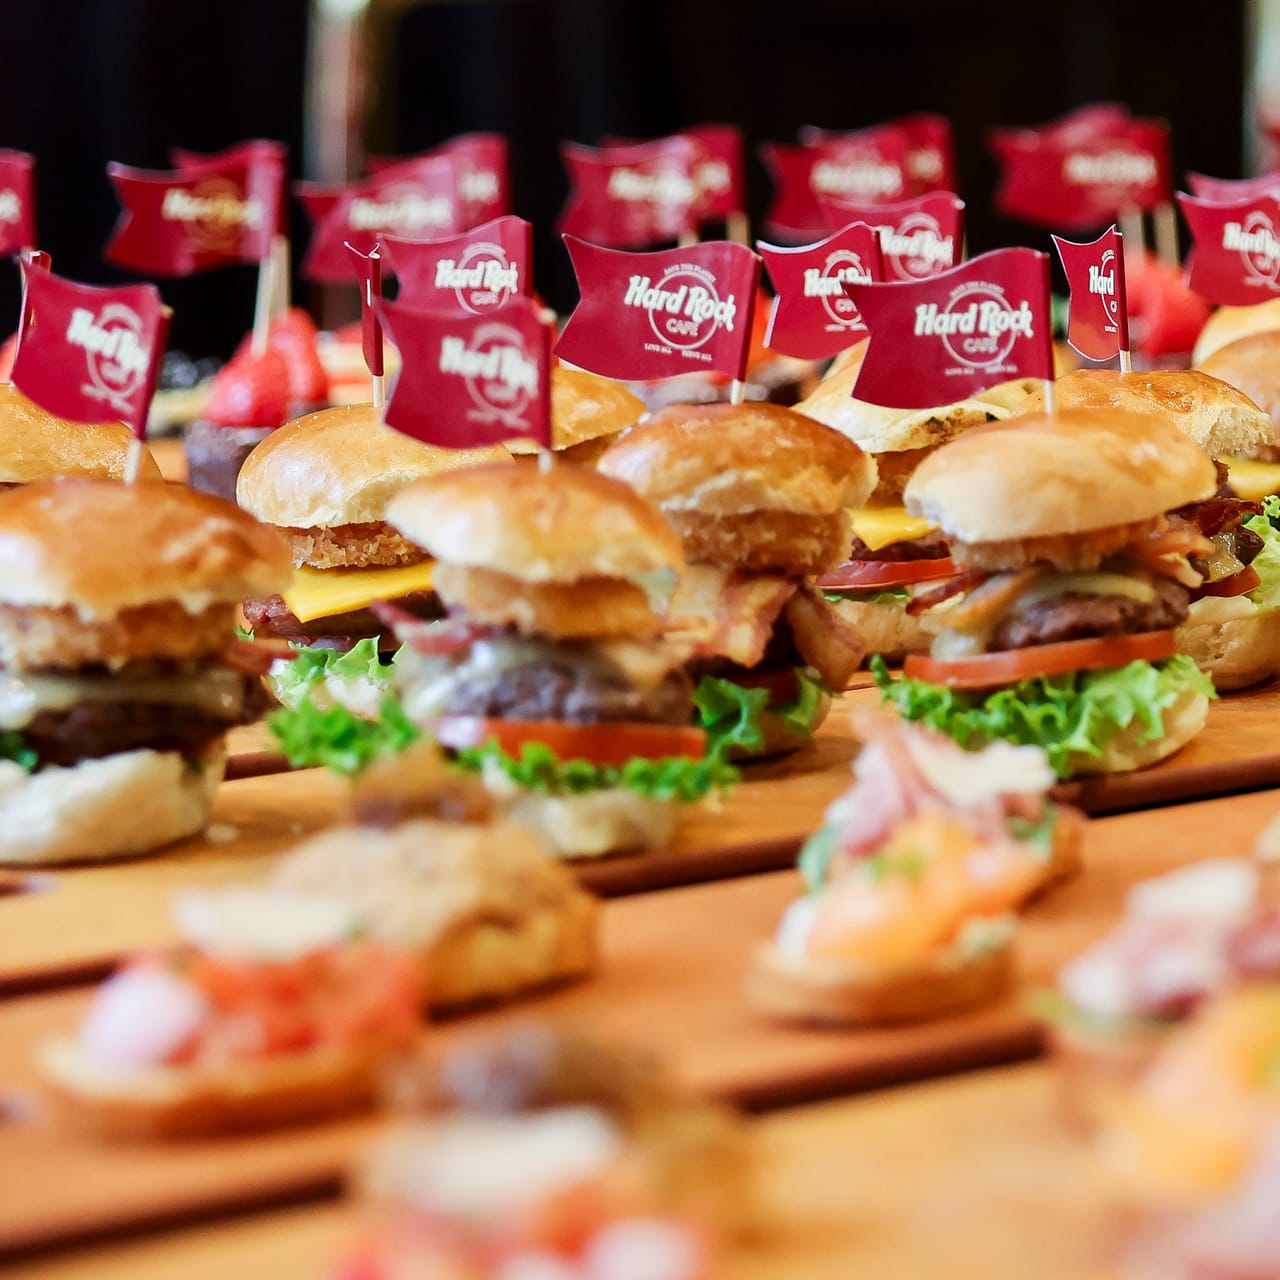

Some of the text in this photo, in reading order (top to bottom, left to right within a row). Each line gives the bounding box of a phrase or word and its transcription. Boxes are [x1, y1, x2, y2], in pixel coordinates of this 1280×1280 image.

[434, 259, 484, 289] Hard
[1089, 265, 1115, 296] Hard
[624, 275, 737, 333] Hard Rock
[914, 300, 1034, 338] Hard Rock
